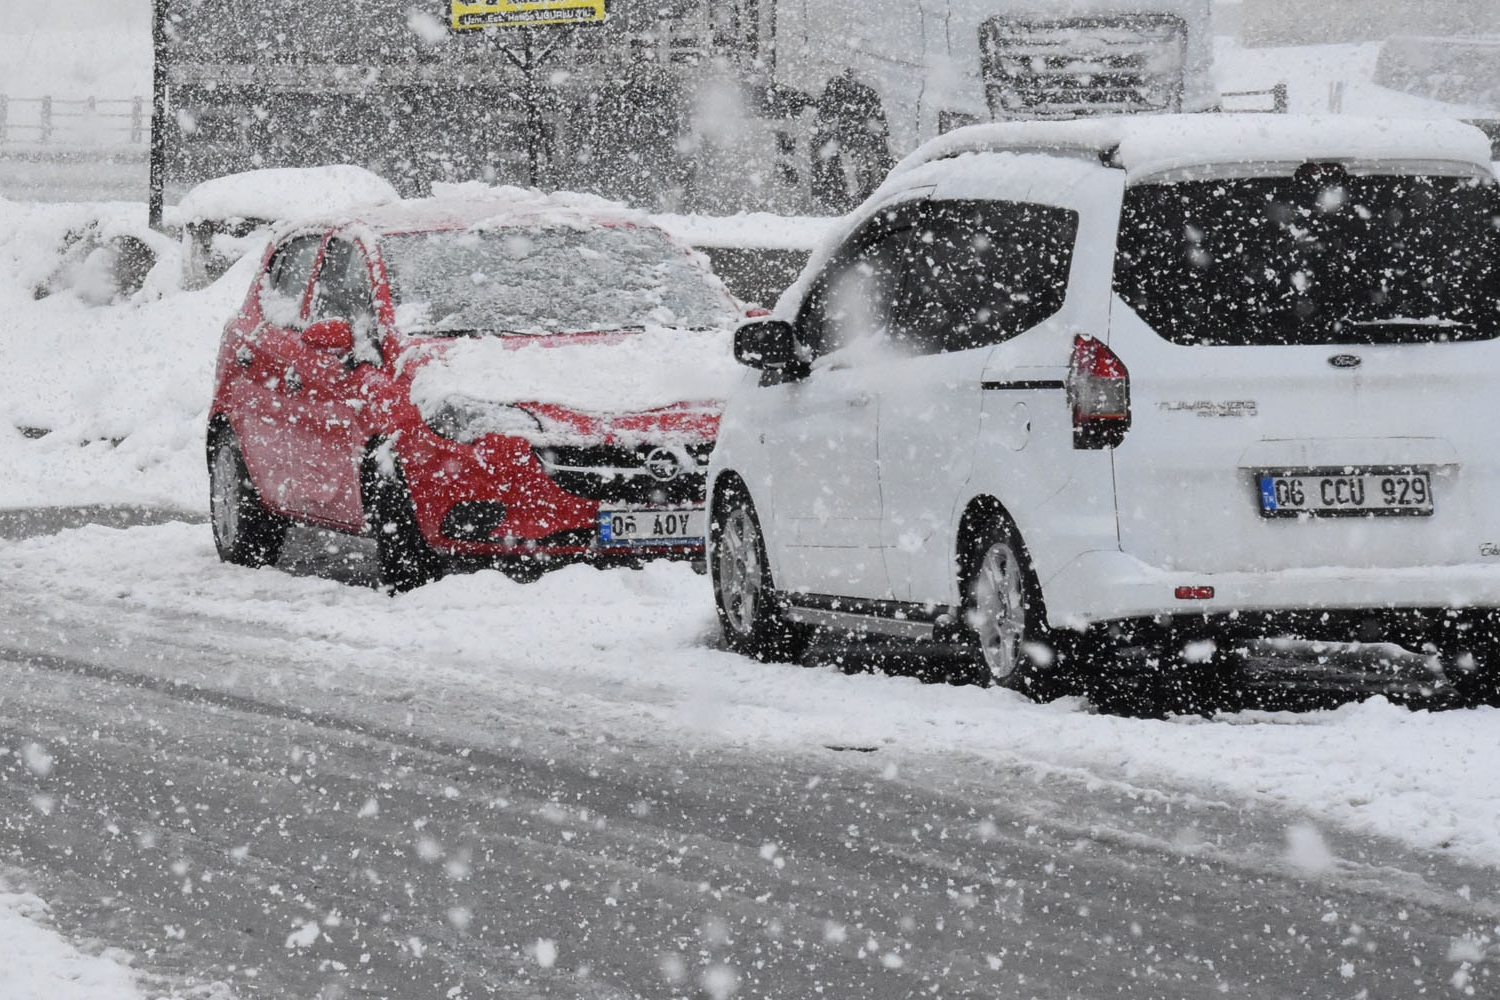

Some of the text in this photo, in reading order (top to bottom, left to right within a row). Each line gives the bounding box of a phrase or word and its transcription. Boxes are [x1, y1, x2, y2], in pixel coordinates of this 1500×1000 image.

[1275, 479, 1305, 506] 06
[1320, 478, 1365, 506] CCU
[1381, 478, 1427, 505] 929
